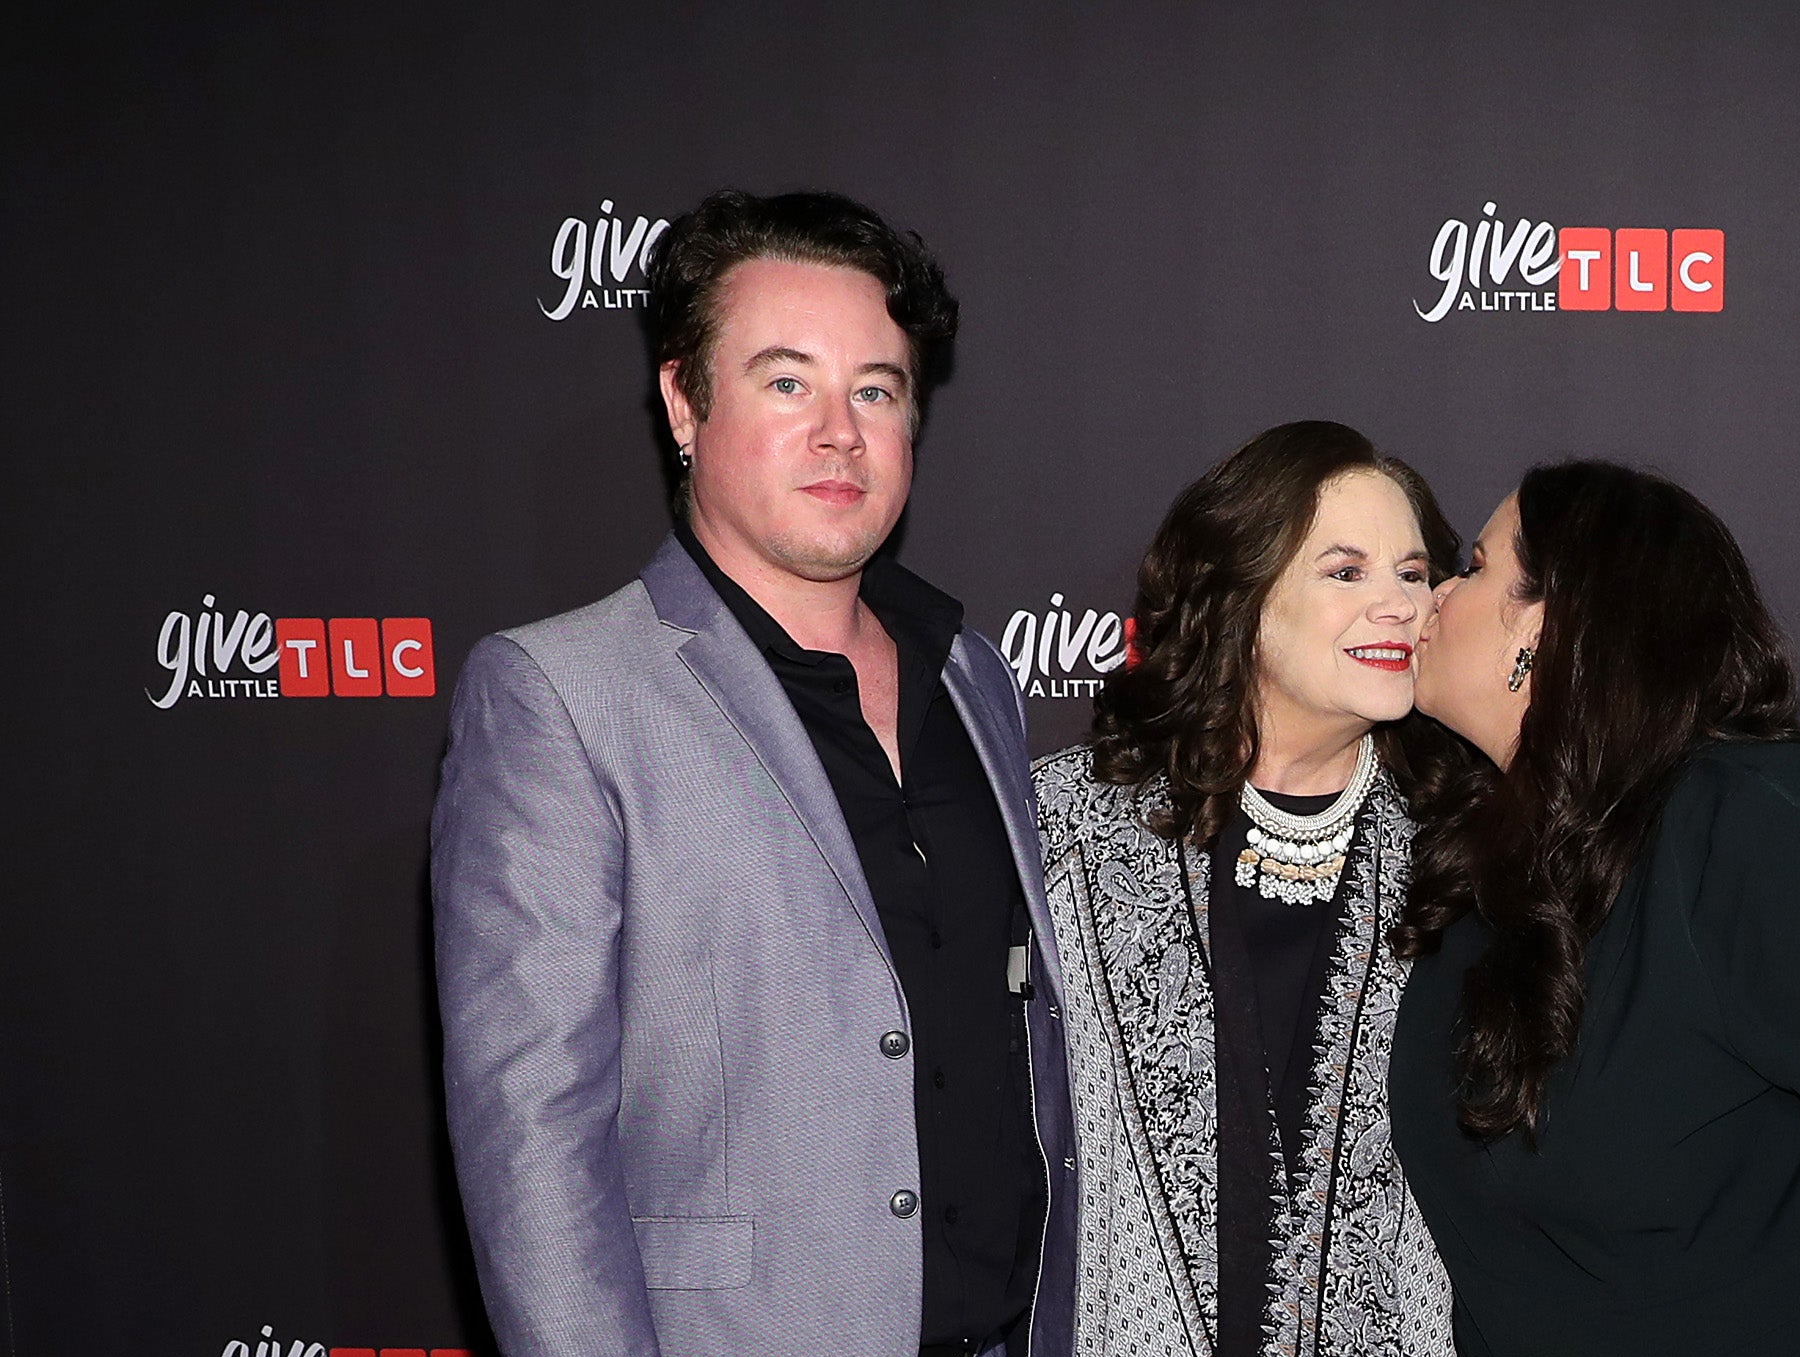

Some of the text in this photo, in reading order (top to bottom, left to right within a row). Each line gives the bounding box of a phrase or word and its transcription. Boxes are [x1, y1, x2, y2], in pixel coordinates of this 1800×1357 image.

[1412, 201, 1567, 323] give
[1567, 250, 1713, 293] TLC
[581, 289, 651, 309] A LITT
[1457, 291, 1556, 312] A LITTLE
[145, 594, 283, 709] give
[285, 639, 424, 678] TLC
[1000, 592, 1130, 704] give
[187, 679, 279, 698] A LITTLE
[1028, 679, 1105, 698] A LITT
